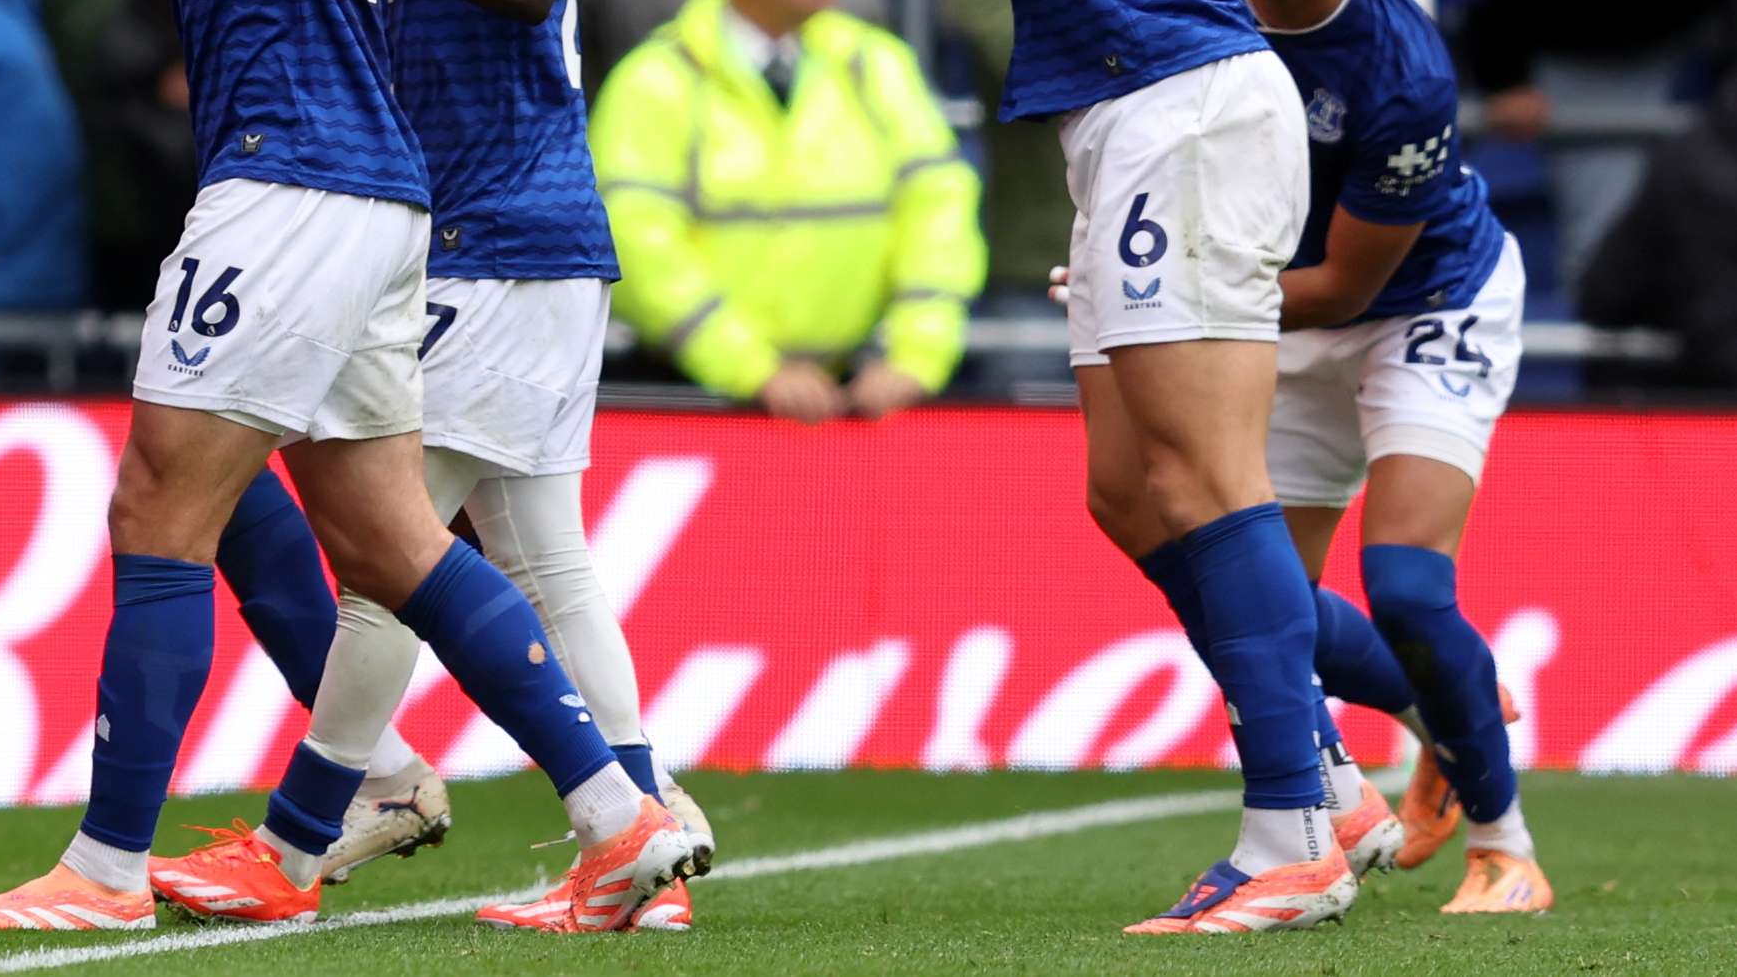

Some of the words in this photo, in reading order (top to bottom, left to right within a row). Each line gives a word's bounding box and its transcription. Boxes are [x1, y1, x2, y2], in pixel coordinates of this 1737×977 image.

[1117, 192, 1168, 268] 6
[167, 256, 244, 337] 16
[416, 301, 458, 361] 7
[1405, 314, 1493, 379] 24
